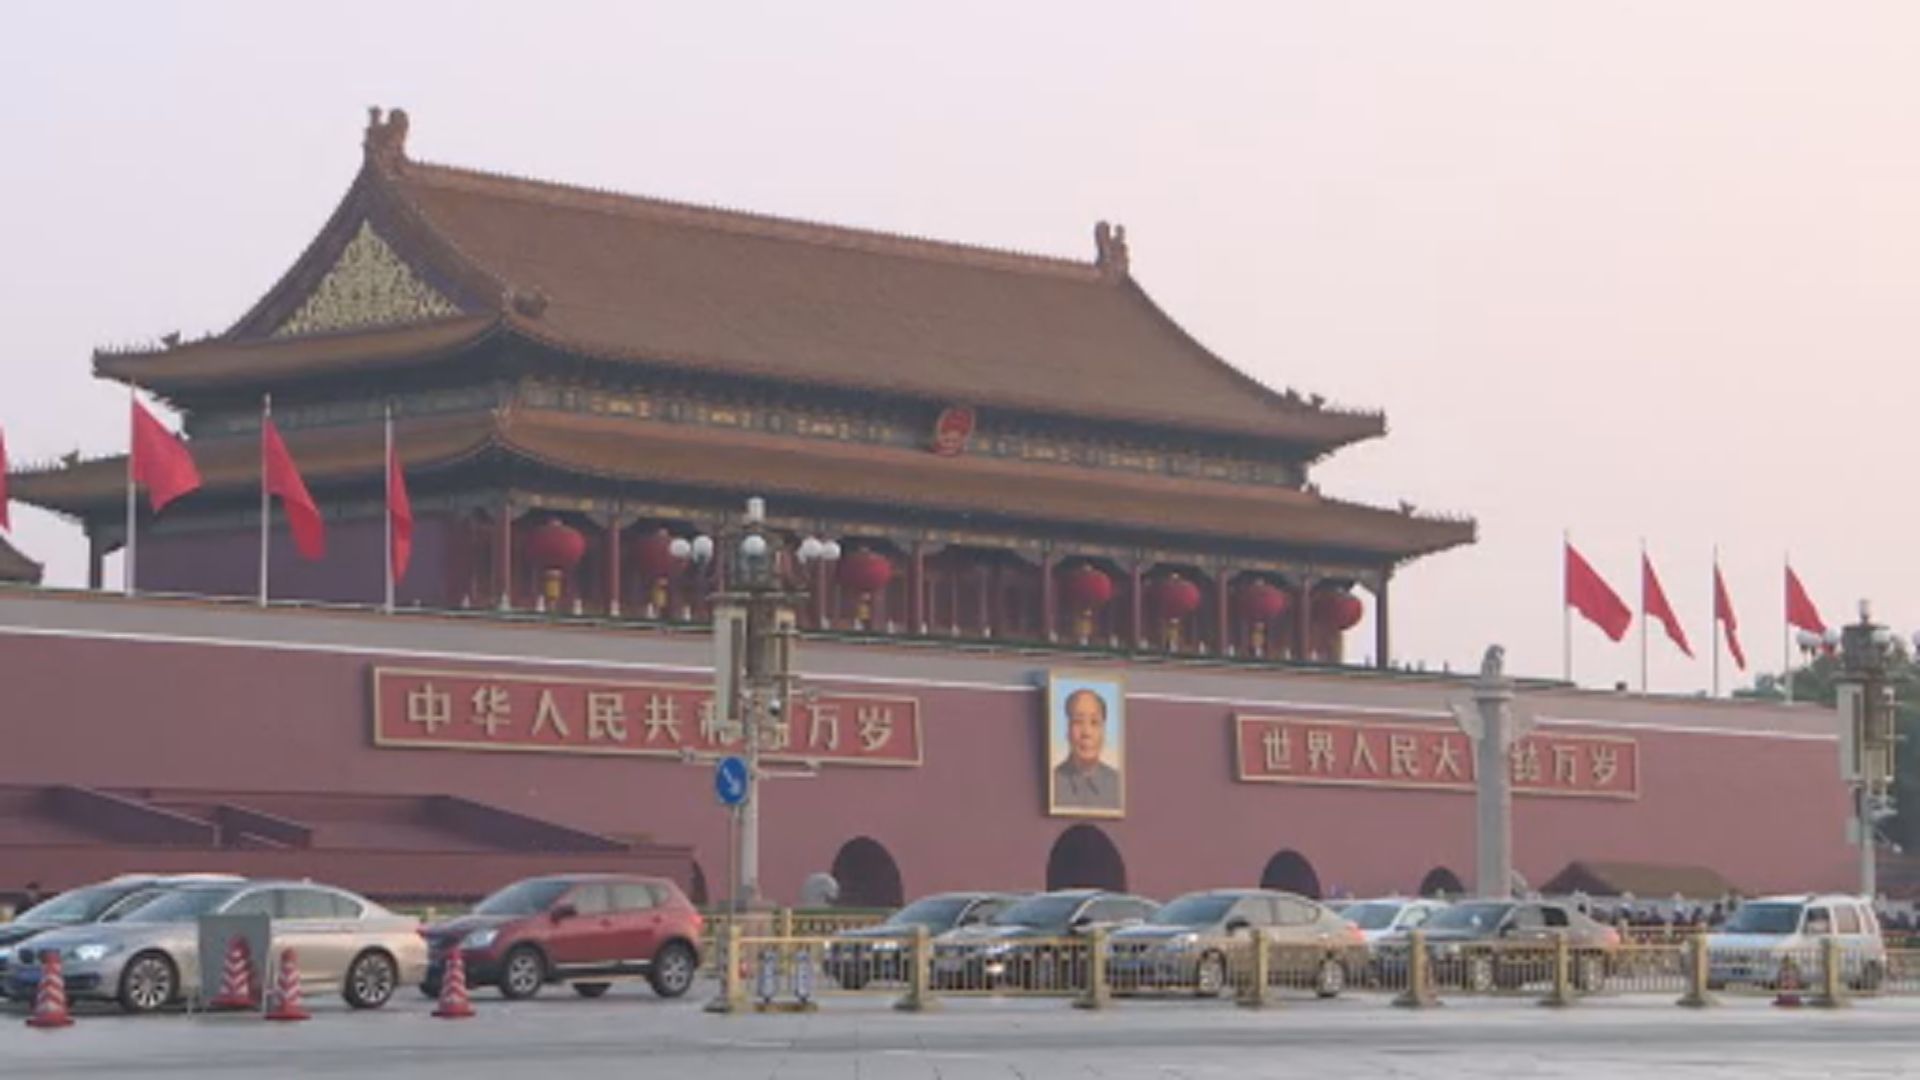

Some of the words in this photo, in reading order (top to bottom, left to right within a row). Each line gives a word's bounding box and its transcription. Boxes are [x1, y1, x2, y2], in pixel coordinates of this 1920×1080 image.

[1263, 728, 1617, 785] 世界人民大结万岁
